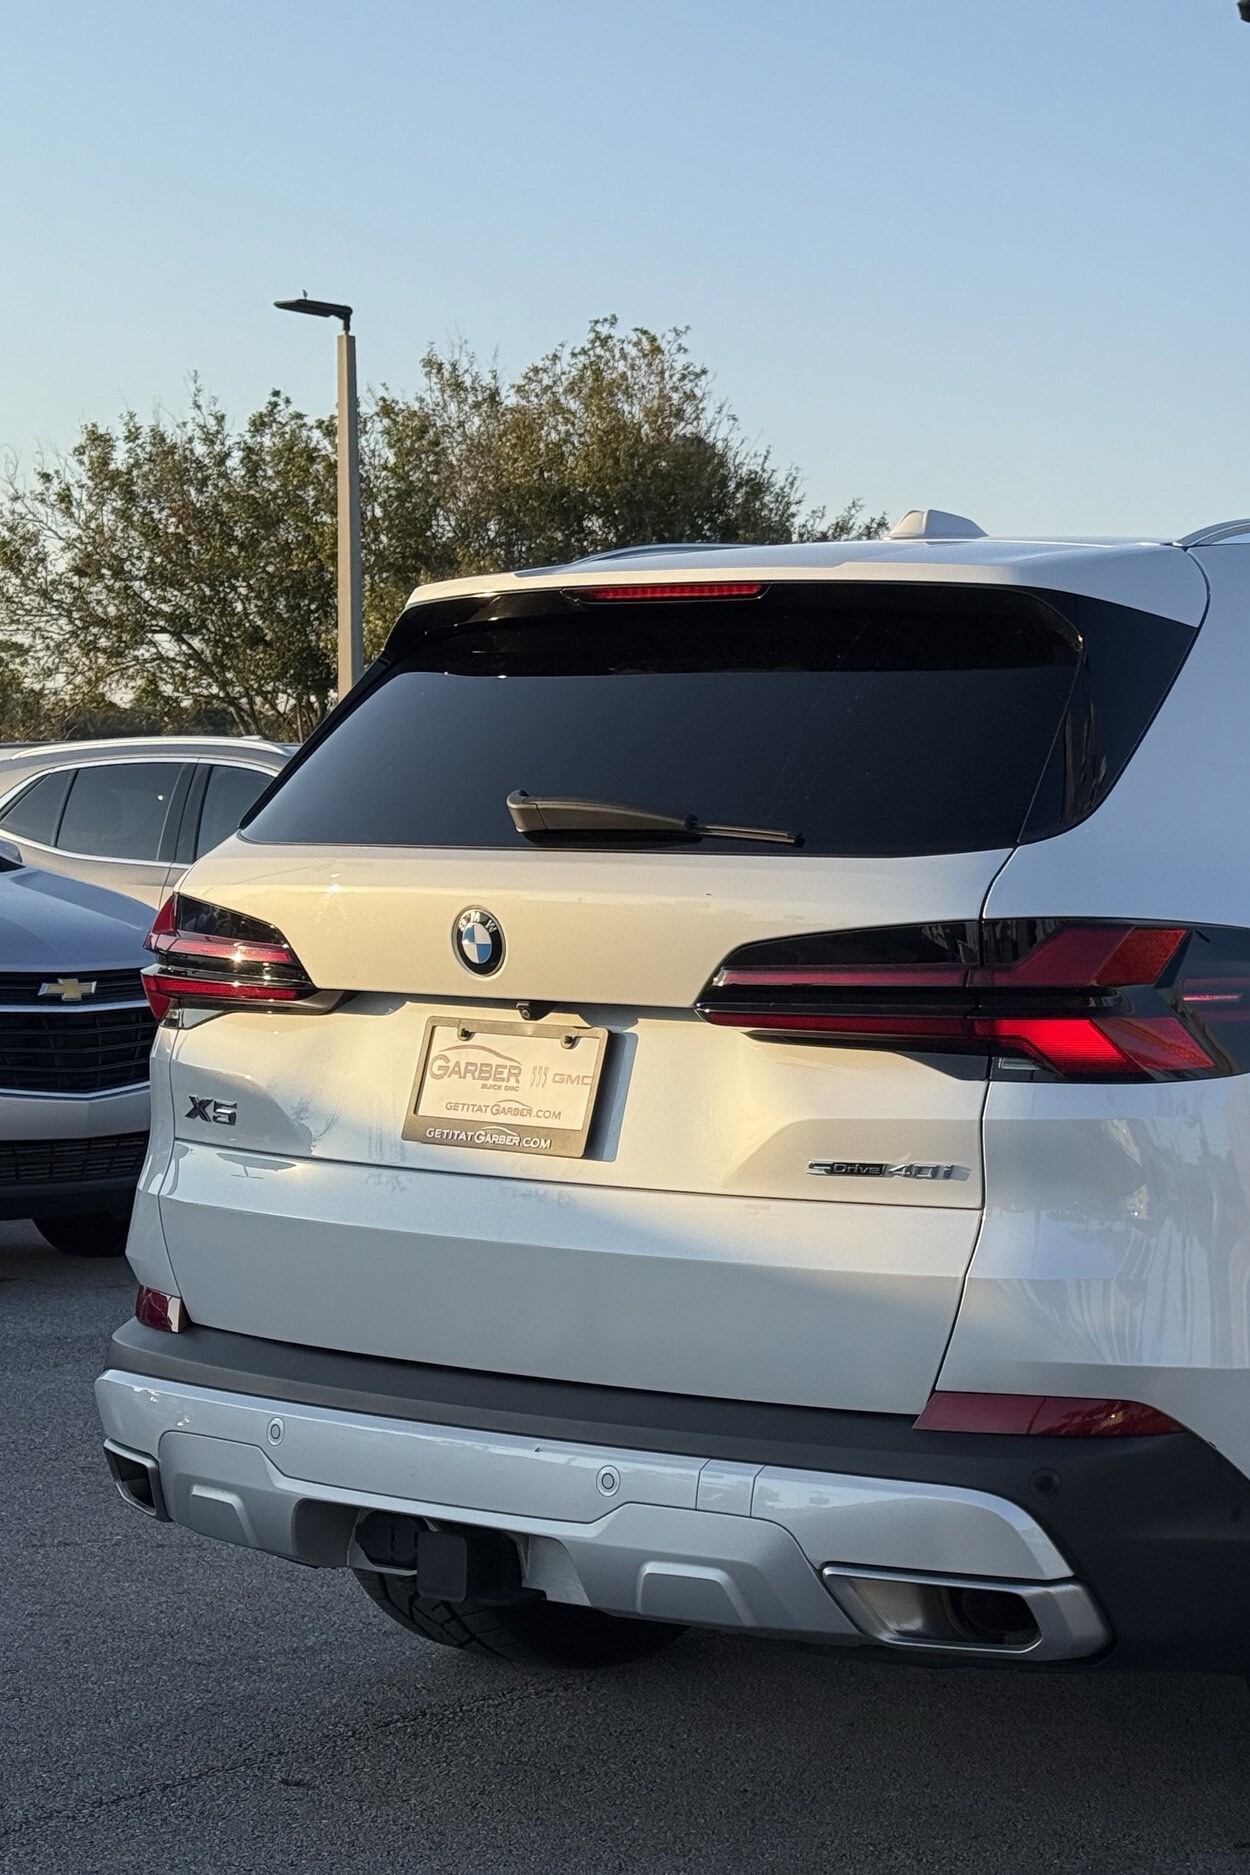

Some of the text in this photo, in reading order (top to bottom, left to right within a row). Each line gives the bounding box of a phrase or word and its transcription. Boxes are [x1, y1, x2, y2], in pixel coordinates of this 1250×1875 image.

[458, 910, 498, 933] BMW
[552, 1073, 594, 1087] GMC
[184, 1094, 238, 1127] X5
